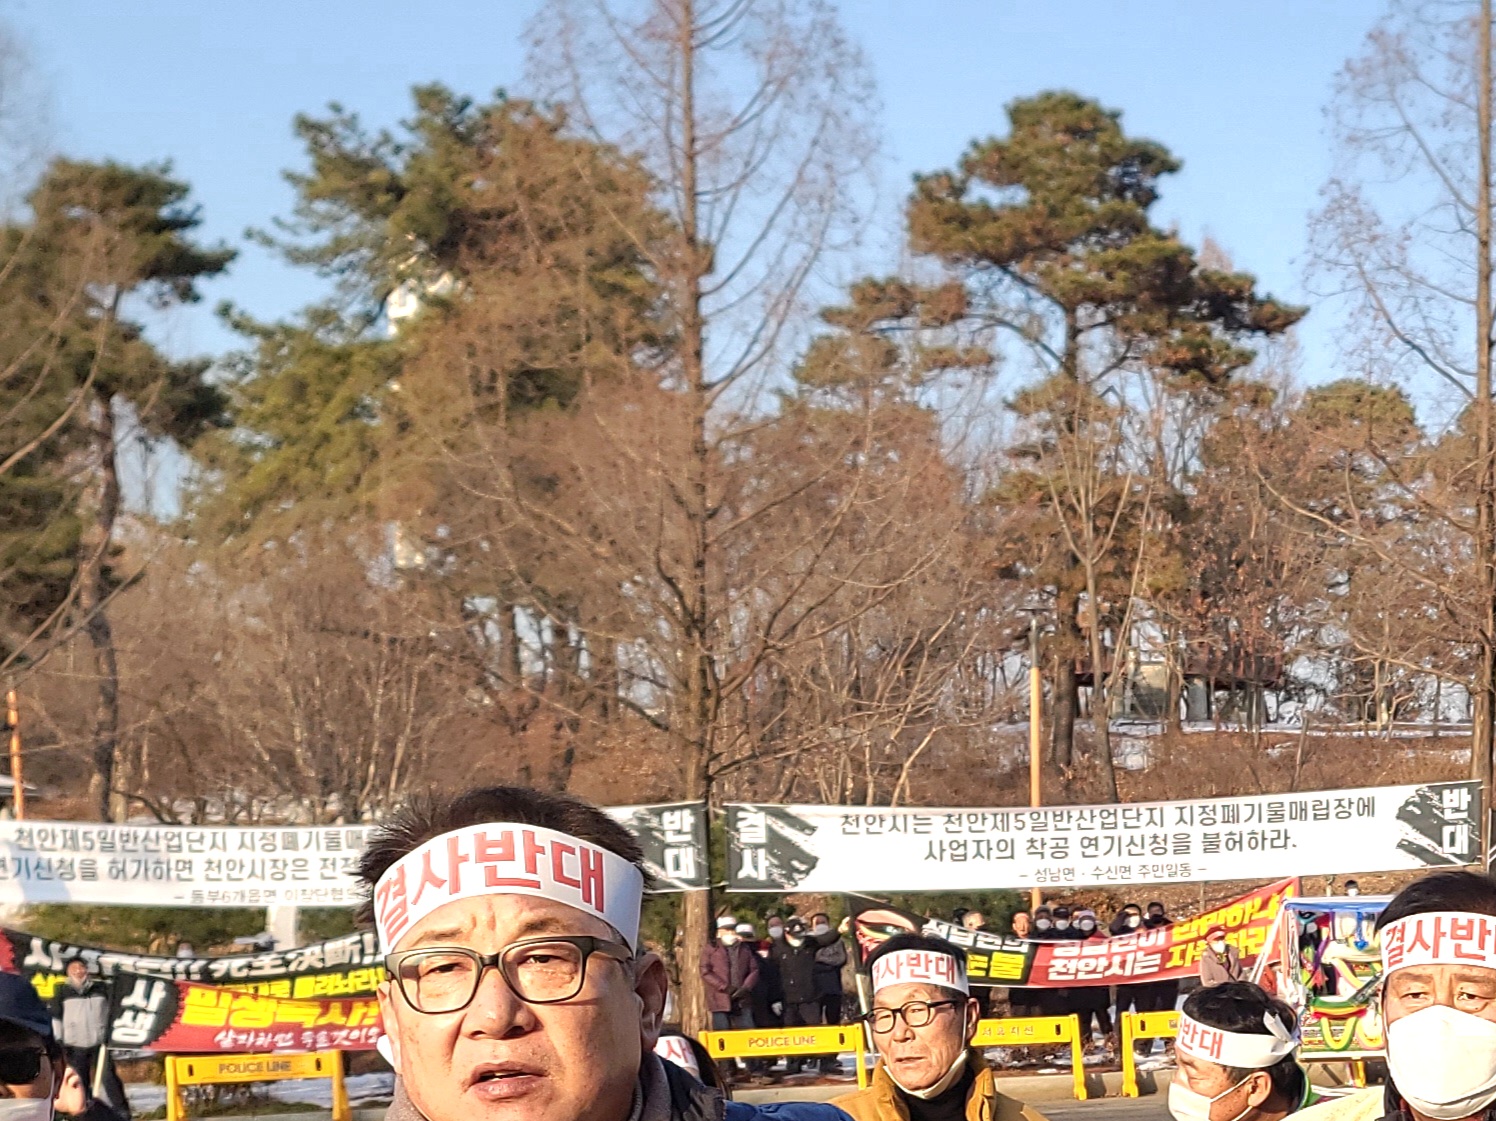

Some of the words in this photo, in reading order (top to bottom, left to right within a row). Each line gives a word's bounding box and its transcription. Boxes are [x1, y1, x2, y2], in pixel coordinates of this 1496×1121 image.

[840, 812, 933, 835] 천안시는
[942, 806, 1165, 834] 천안제5일반산업단지
[1175, 795, 1377, 828] 지정폐기물매립장에
[1442, 787, 1472, 855] 반대
[14, 826, 228, 854] 천안제5일반산업단지
[238, 828, 374, 852] 지정폐기물매
[662, 810, 696, 880] 반대
[735, 811, 771, 881] 결사
[924, 837, 1015, 863] 사업자의
[1025, 836, 1070, 860] 착공
[1080, 831, 1193, 860] 연기신청을
[1200, 827, 1297, 856] 불허하라.
[107, 856, 194, 882] 허가하면
[203, 856, 311, 881] 천안시장은
[375, 830, 605, 936] 결사반대
[1034, 867, 1075, 883] 성남면
[1090, 864, 1132, 881] 수신면
[1137, 862, 1192, 880] 주민일동
[1048, 950, 1162, 982] 천안시는
[111, 979, 167, 1044] 사생
[748, 1037, 790, 1048] POLICE
[792, 1035, 816, 1046] LINE
[1181, 1017, 1234, 1059] 반대
[218, 1061, 262, 1074] POLICE
[265, 1060, 292, 1073] LINE
